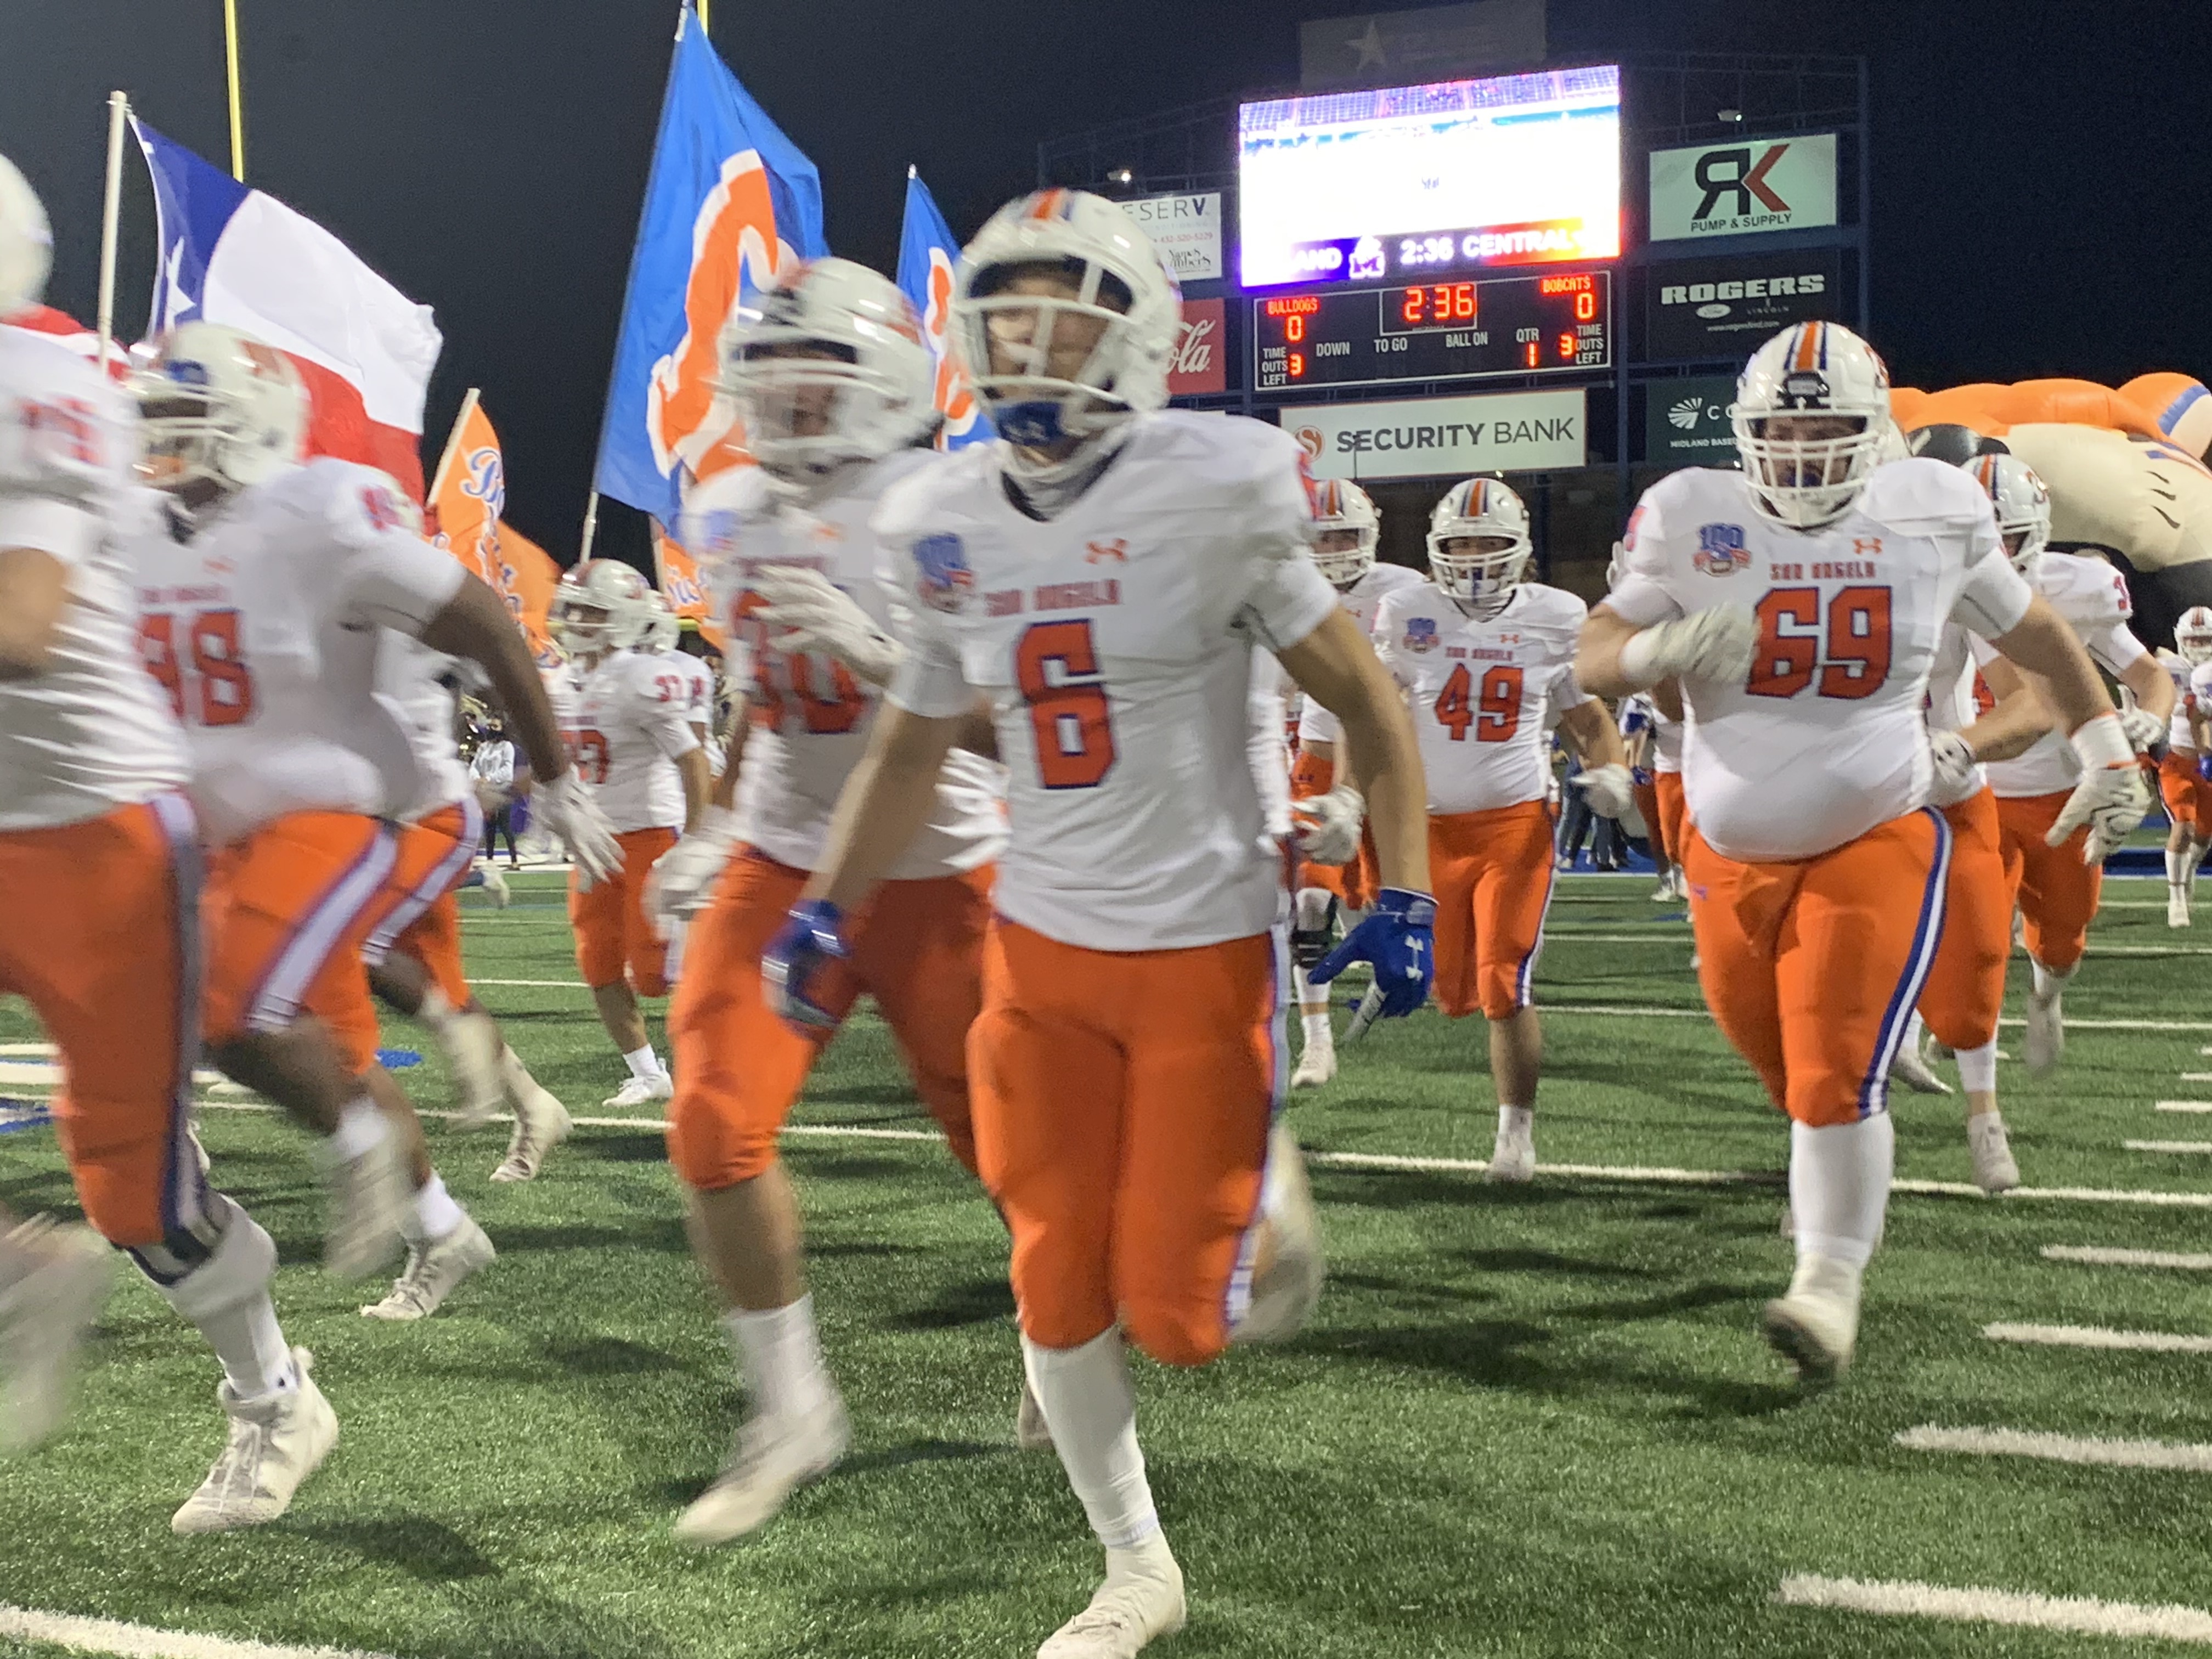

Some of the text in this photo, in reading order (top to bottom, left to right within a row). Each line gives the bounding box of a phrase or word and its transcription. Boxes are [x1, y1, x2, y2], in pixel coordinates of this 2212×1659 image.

[1691, 213, 1792, 232] PUMP & SUPPLY
[1400, 237, 1453, 266] 2:36
[1463, 229, 1574, 258] CENTRAL
[1542, 275, 1591, 294] BOBCATS
[1661, 274, 1825, 304] ROGERS
[1267, 297, 1319, 315] BULLDOGS
[1402, 284, 1474, 320] 2:36
[1576, 292, 1594, 319] 0
[1287, 315, 1302, 341] 0
[1516, 328, 1539, 342] QTR
[1576, 324, 1602, 336] TIME
[1374, 337, 1408, 353] TO GO
[1446, 331, 1488, 347] BALL ON
[1560, 335, 1573, 357] 3
[1576, 337, 1604, 351] OUTS
[1263, 347, 1287, 359] TIME
[1316, 342, 1351, 357] DOWN
[1527, 342, 1536, 368] 1
[1576, 351, 1602, 365] LEFT
[1262, 360, 1289, 373] OUTS
[1289, 353, 1302, 376] 3
[1263, 374, 1287, 386] LEFT
[1336, 423, 1486, 453] SECURITY
[1494, 417, 1575, 444] BANK
[1670, 439, 1710, 448] MIDLAND
[1746, 586, 1892, 699] 69
[1014, 618, 1115, 790] 6
[1435, 663, 1523, 742] 49
